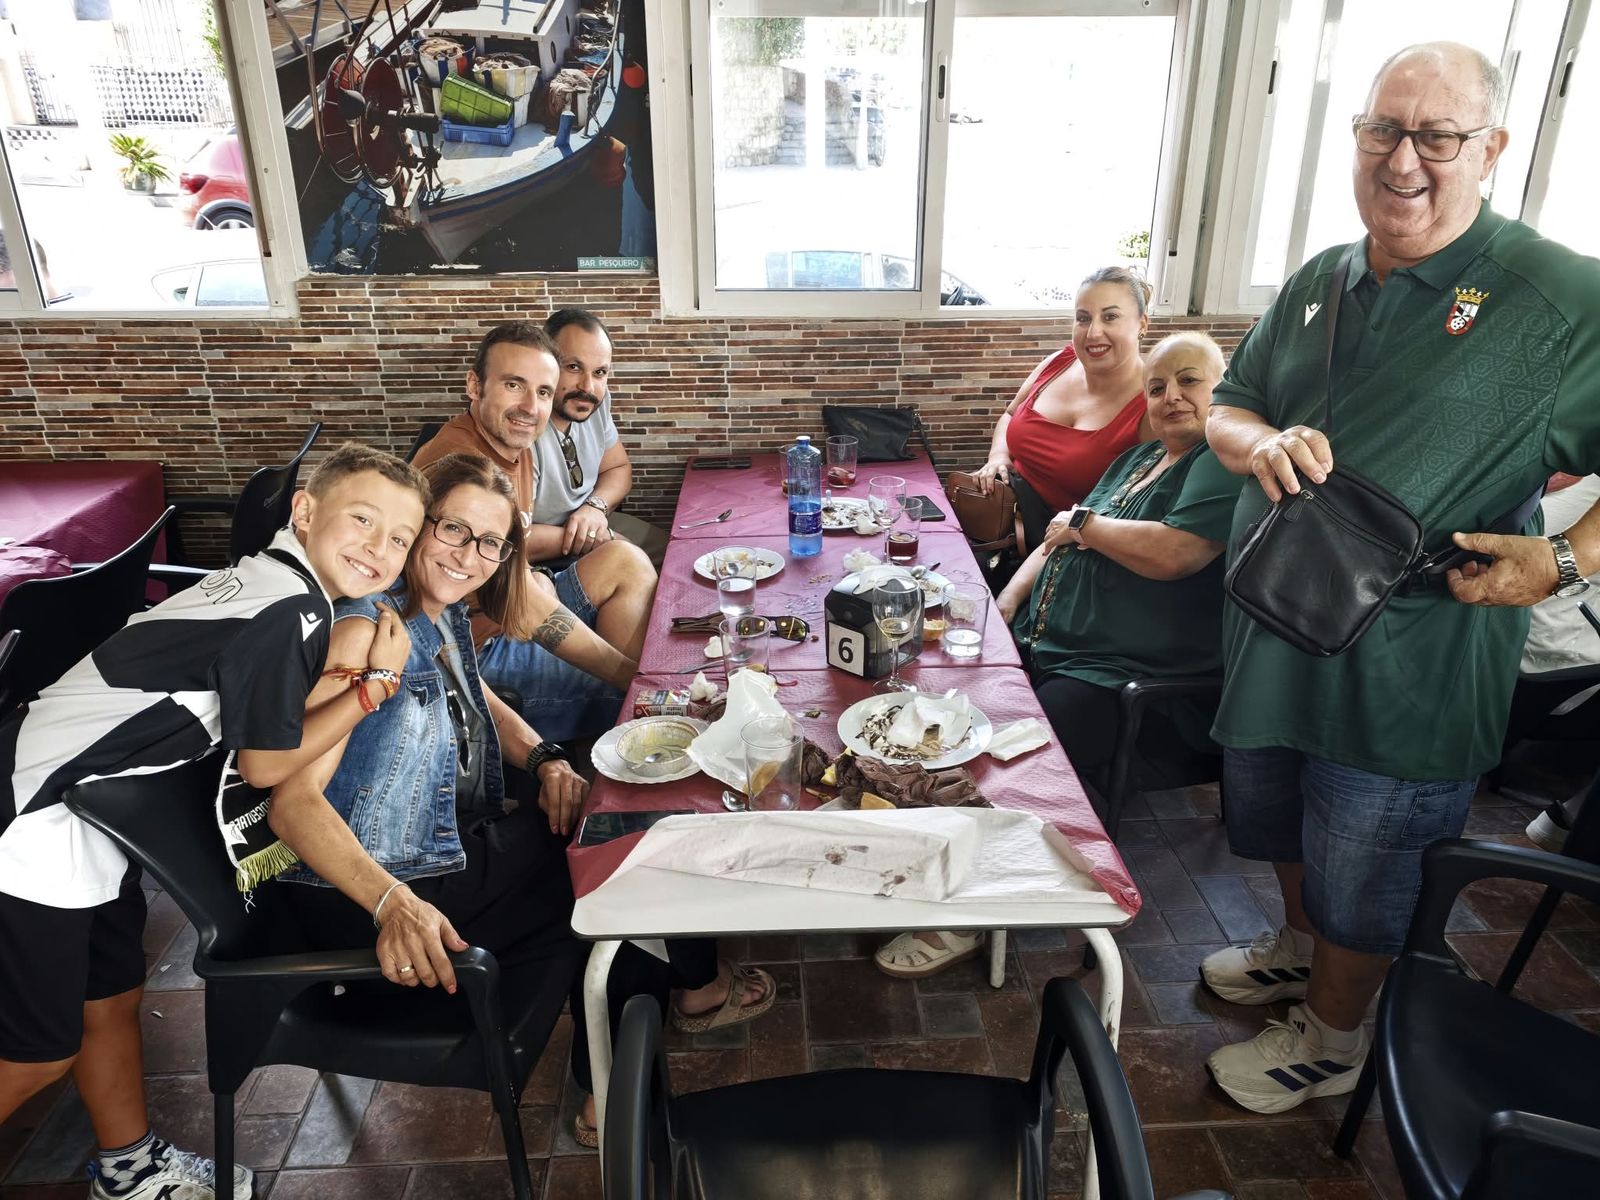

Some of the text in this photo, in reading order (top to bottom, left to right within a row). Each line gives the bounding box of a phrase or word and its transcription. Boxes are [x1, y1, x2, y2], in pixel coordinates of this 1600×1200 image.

[580, 259, 639, 268] BAR PESQUERO
[838, 637, 854, 664] 6
